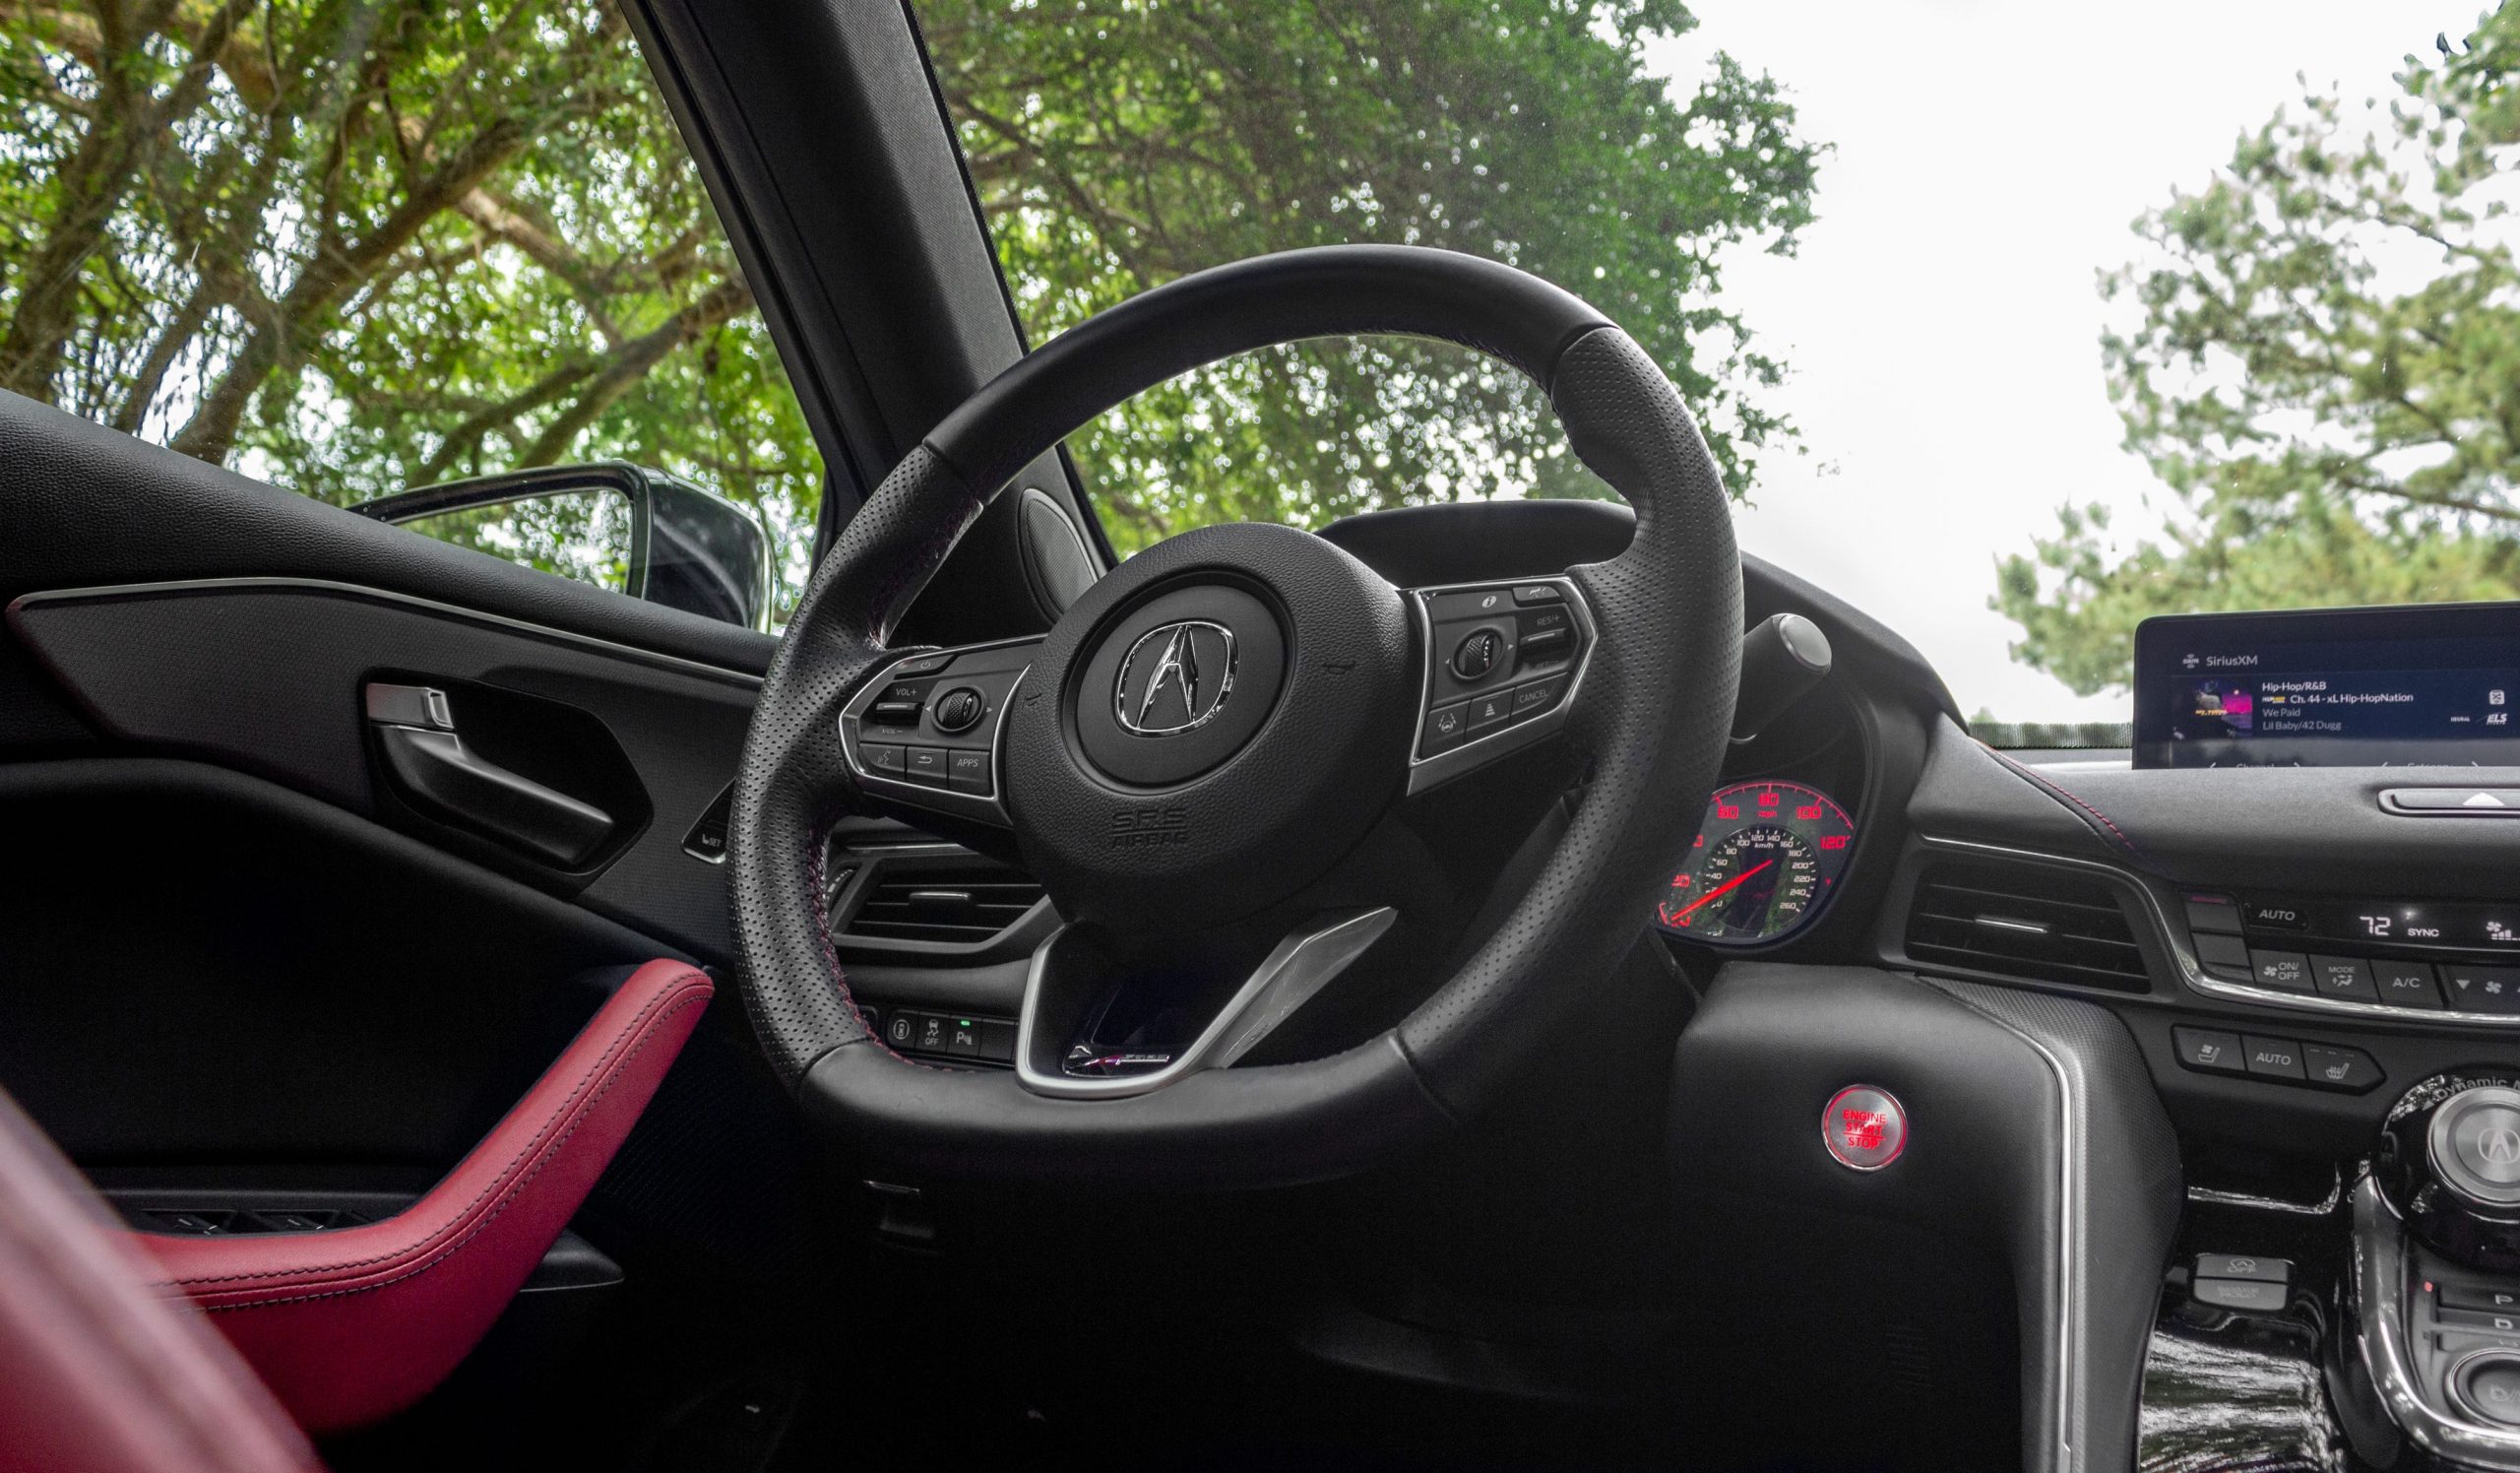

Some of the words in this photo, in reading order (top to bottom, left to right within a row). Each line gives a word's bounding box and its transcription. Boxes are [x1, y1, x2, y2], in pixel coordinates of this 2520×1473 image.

[1537, 614, 1560, 627] RES/+
[2206, 655, 2258, 667] SiriusXM
[2262, 680, 2327, 693] Hip-Hop/R&B
[1519, 689, 1548, 703] CANCEL
[2290, 694, 2305, 704] Ch.
[2307, 694, 2320, 703] 44
[2327, 694, 2339, 703] xL
[2340, 692, 2414, 704] Hip-HopNation
[2262, 708, 2280, 717] We
[2280, 708, 2300, 717] Paid
[2487, 713, 2507, 723] ELS
[2262, 721, 2274, 731] Lil
[2275, 720, 2314, 732] Baby/42
[2315, 720, 2342, 731] Dugg
[957, 758, 978, 767] APPS
[1796, 805, 1822, 820] 100
[1820, 835, 1846, 850] 120
[2259, 909, 2296, 921] AUTO
[2360, 916, 2391, 936] 72
[2408, 928, 2440, 937] SYNC
[2278, 962, 2300, 971] ON/
[2278, 971, 2300, 981] OFF
[2392, 978, 2421, 989] A/C
[925, 1037, 939, 1046] OFF
[2255, 1052, 2292, 1065] AUTO
[2432, 1076, 2508, 1102] Dynamic
[1843, 1109, 1888, 1124] ENGINE
[1846, 1121, 1883, 1135] START
[1848, 1137, 1879, 1150] STOP
[2494, 1294, 2514, 1305] P
[2494, 1317, 2514, 1330] D
